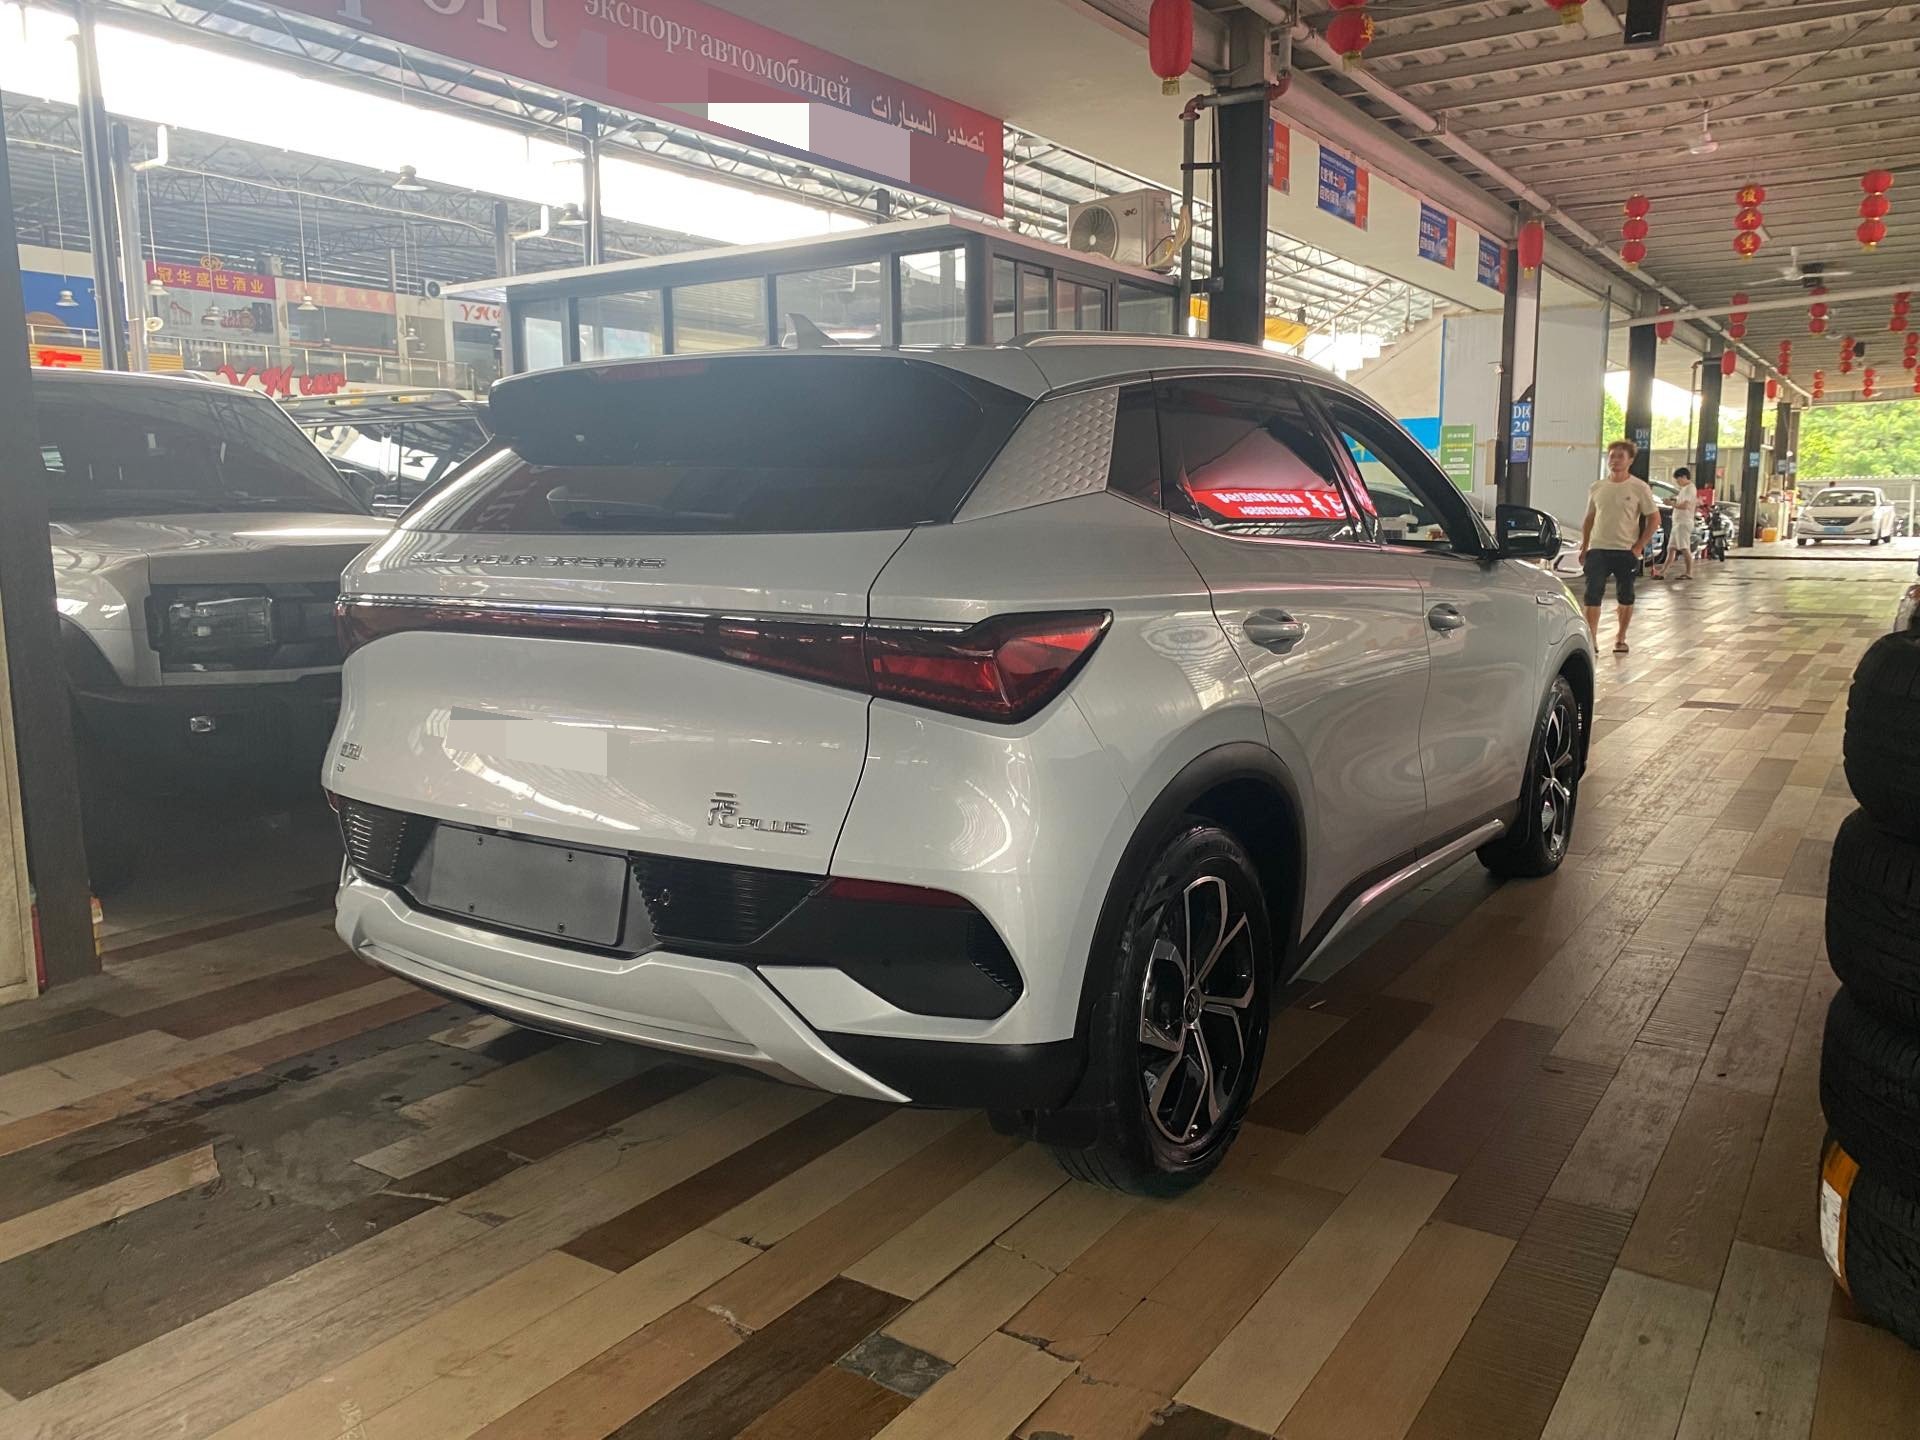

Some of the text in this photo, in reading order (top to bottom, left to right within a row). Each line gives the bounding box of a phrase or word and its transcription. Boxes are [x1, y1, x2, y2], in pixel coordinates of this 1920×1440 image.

[700, 33, 852, 107] автомобилей
[871, 94, 937, 136] السيارات
[1513, 420, 1530, 433] 20
